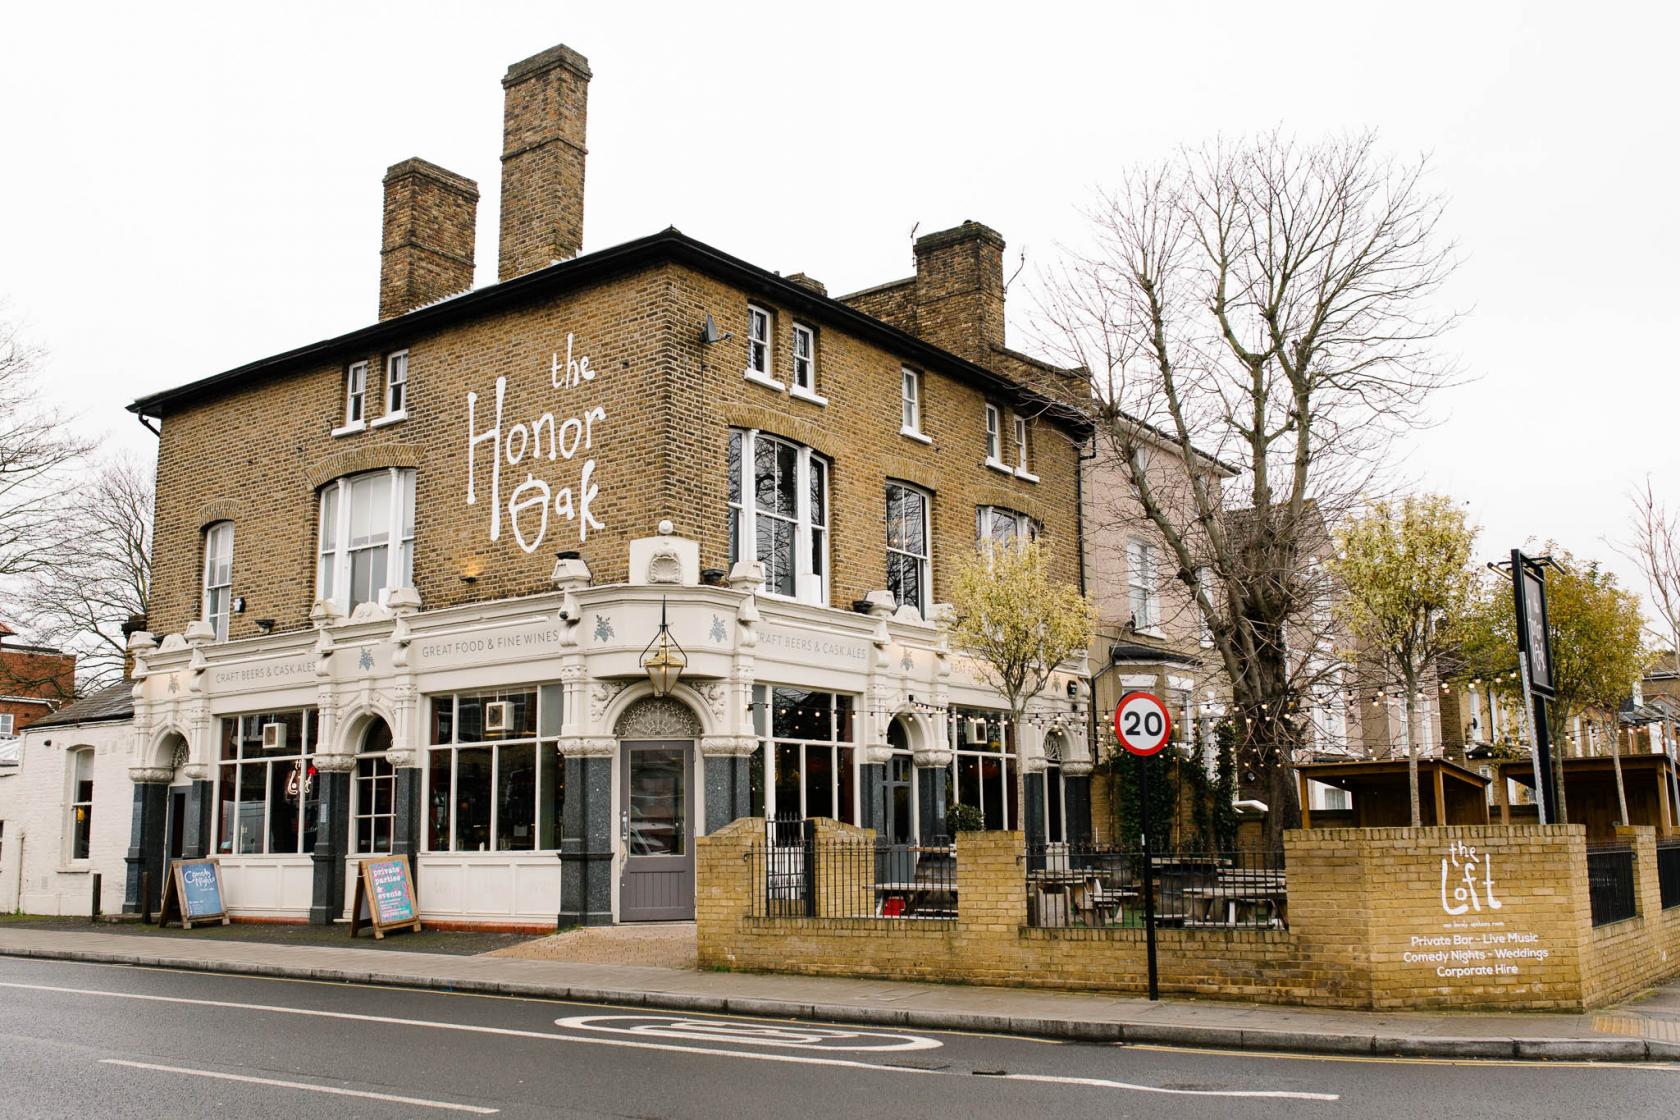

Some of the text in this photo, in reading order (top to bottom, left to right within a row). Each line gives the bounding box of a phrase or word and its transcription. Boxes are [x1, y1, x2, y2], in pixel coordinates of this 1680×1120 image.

[552, 332, 596, 389] the
[467, 376, 607, 542] Honor
[508, 459, 606, 554] Oak
[422, 630, 559, 658] GREAT FOOD & FINE WINES
[785, 637, 812, 652] BEERS
[814, 642, 820, 653] &
[822, 642, 845, 656] CASK
[847, 647, 867, 659] ALES
[216, 671, 240, 683] CRAFT
[241, 668, 265, 681] BEERS
[266, 666, 272, 677] &
[273, 664, 297, 676] CASK
[1124, 711, 1163, 737] 20
[1449, 840, 1480, 867] the
[1441, 853, 1502, 916] Loft
[1411, 935, 1451, 947] Private
[1453, 934, 1474, 945] Bar
[1482, 933, 1506, 944] Live
[1507, 932, 1539, 943] Music
[1403, 951, 1449, 964] Comedy
[1451, 950, 1486, 964] Nights
[1495, 948, 1549, 961] Weddings
[1436, 964, 1519, 978] Corporate Hire
